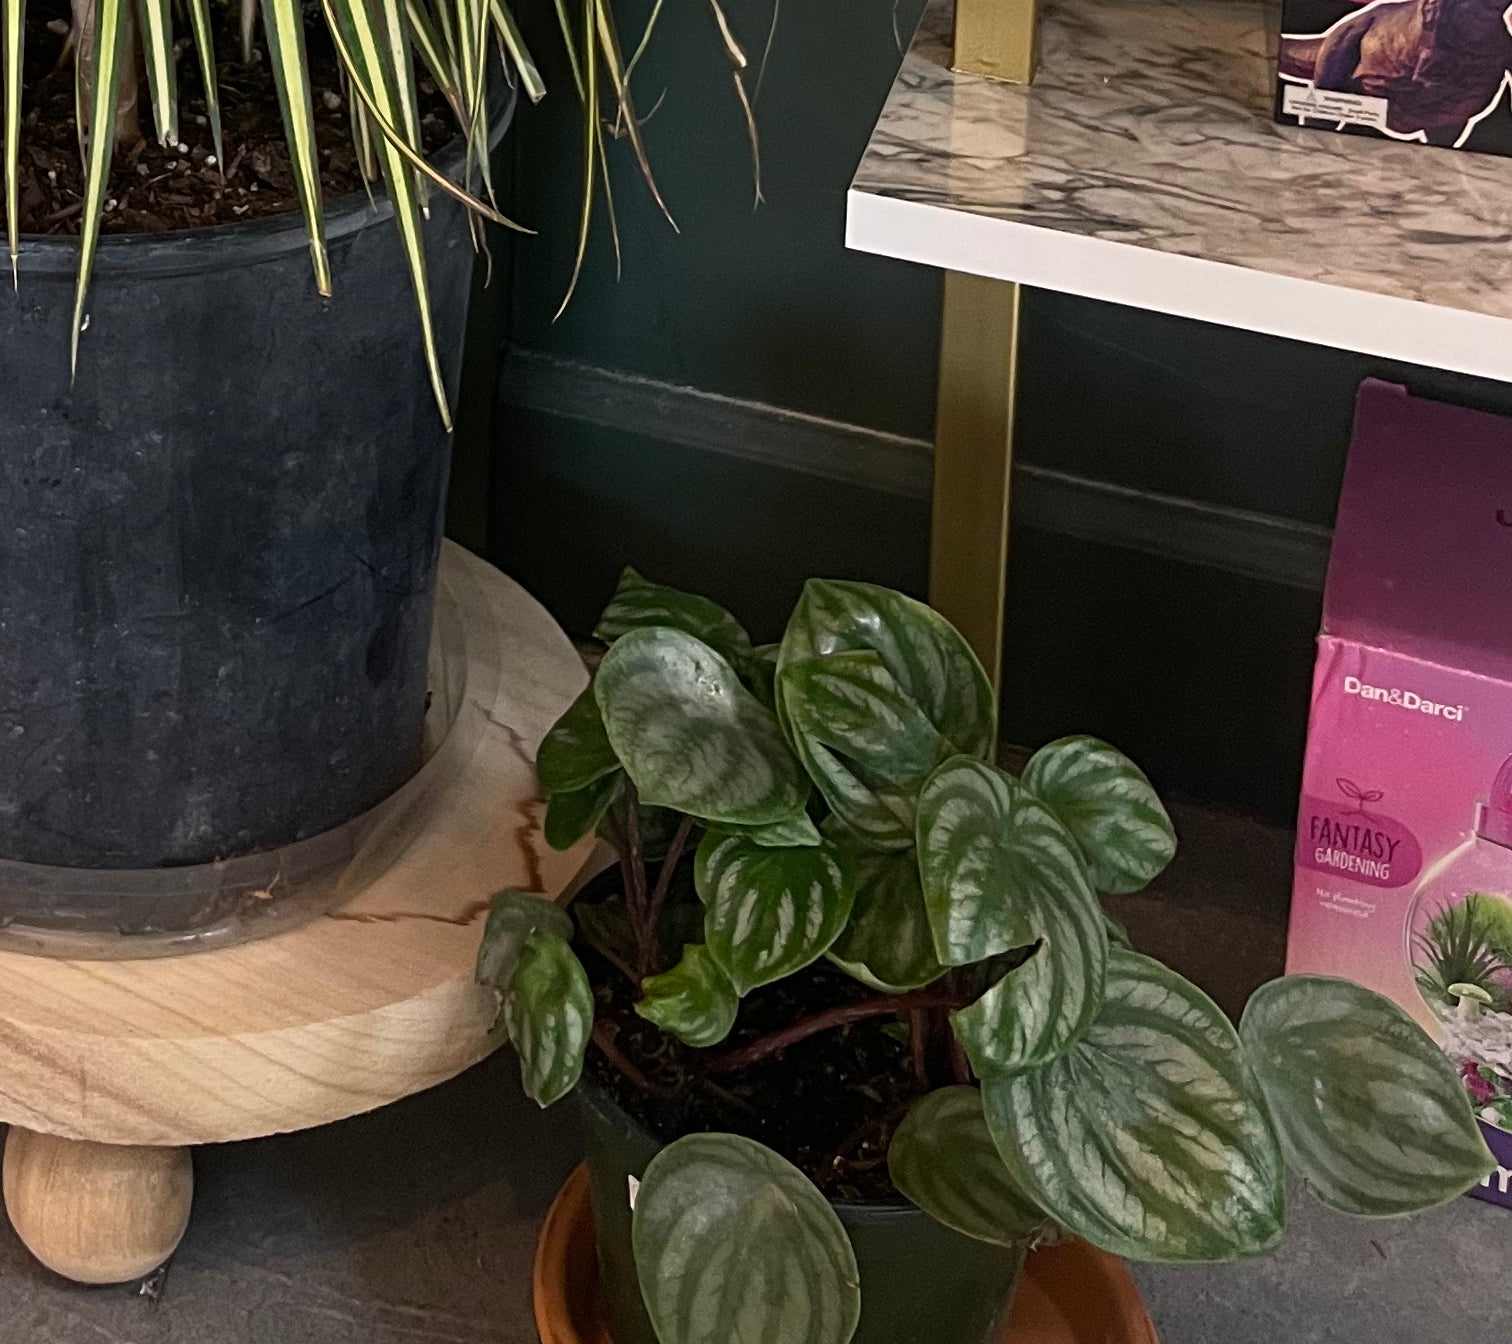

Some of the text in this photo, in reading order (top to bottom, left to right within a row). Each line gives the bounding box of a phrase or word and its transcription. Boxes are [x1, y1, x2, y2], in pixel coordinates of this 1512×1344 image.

[1344, 676, 1464, 722] Dan&Darci
[1310, 815, 1401, 862] FANTASY
[1314, 847, 1391, 880] GARDENING
